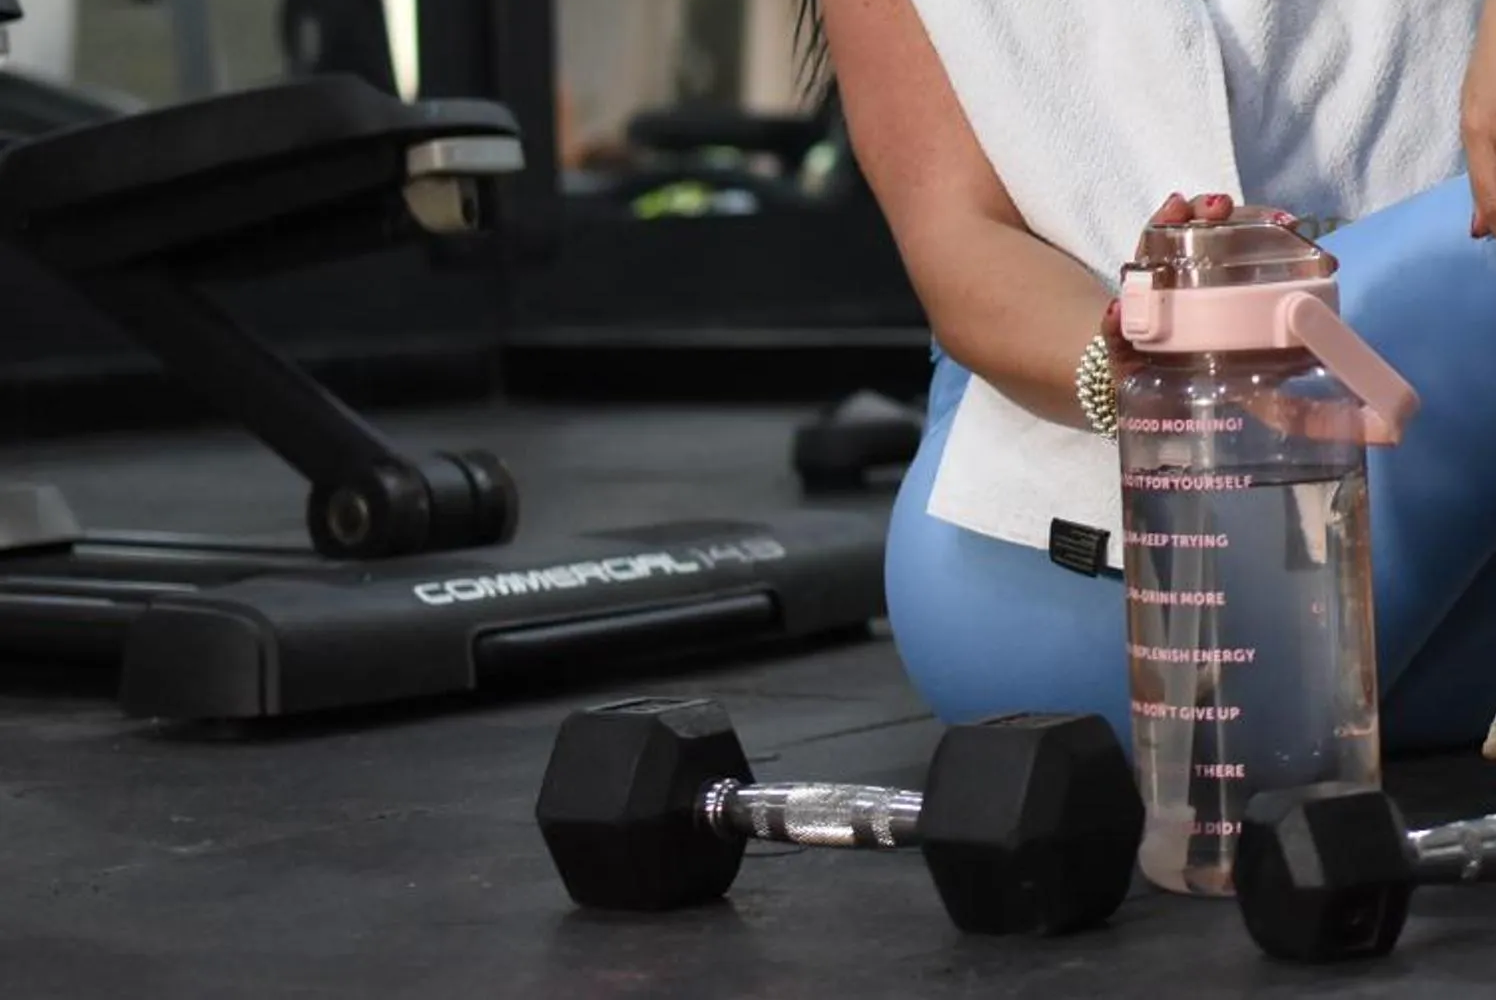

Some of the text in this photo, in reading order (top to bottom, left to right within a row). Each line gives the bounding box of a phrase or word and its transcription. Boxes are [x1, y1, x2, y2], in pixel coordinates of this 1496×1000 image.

[1162, 418, 1244, 433] MORNING!
[1172, 474, 1253, 491] YOURSELF
[1171, 533, 1229, 548] TRYING
[1180, 591, 1226, 606] MORE
[1192, 648, 1256, 663] ENERGY
[1179, 706, 1215, 720] GIVE
[1217, 707, 1241, 720] UP
[1194, 764, 1245, 778] THERE
